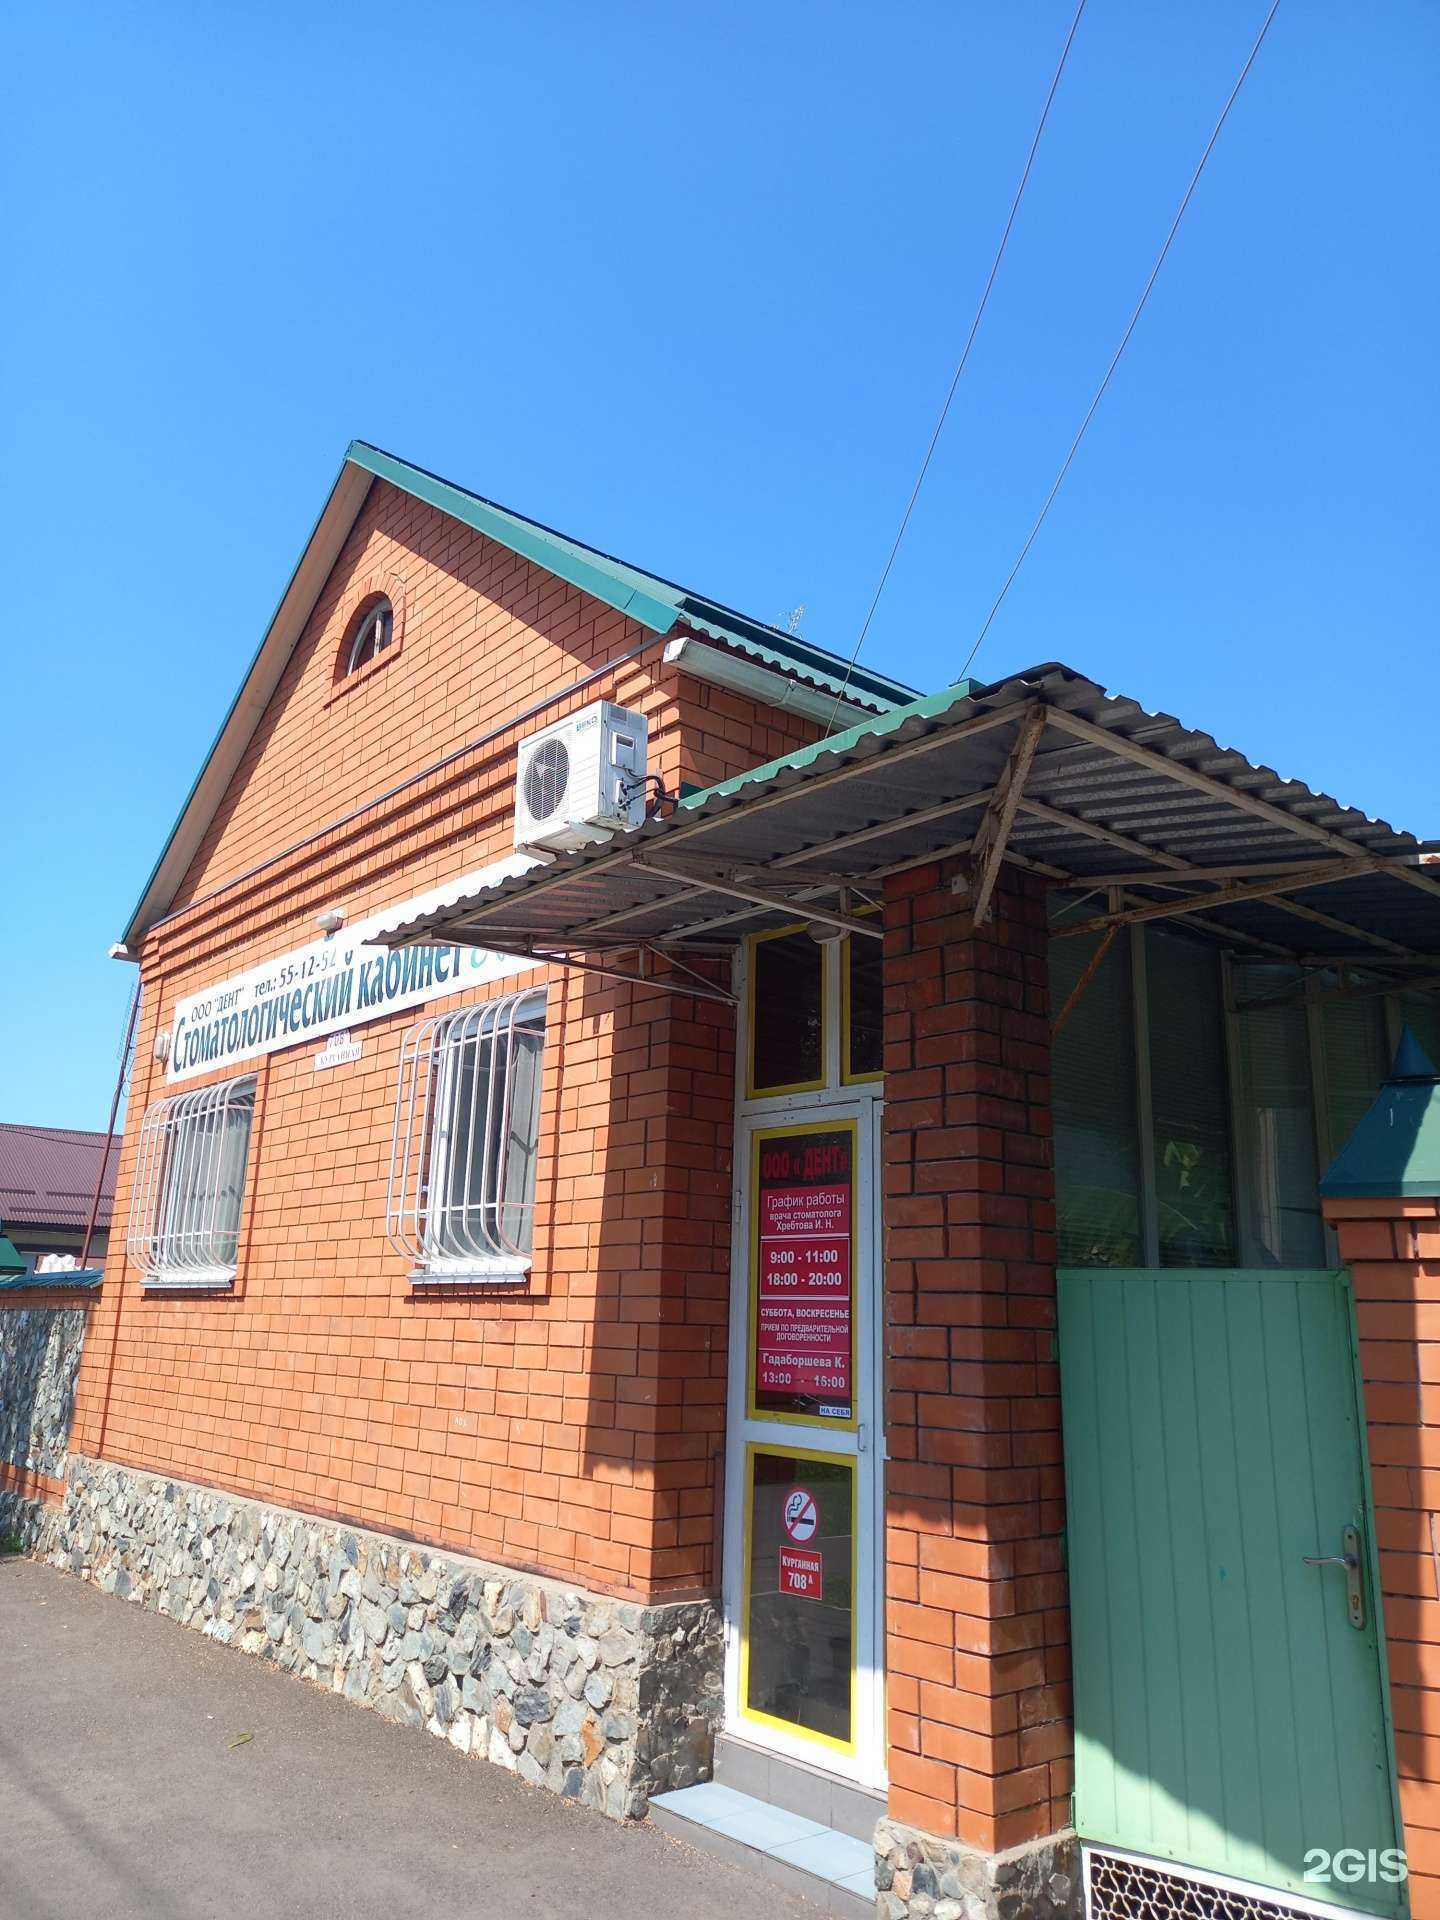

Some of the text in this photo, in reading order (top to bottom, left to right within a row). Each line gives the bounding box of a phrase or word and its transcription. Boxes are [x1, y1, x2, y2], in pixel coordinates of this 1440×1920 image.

[173, 949, 355, 1073] Стоматологический
[191, 1001, 212, 1022] ООО
[214, 987, 245, 1013] "ДЕНТ"
[764, 1151, 789, 1179] ООО
[767, 1192, 845, 1210] График работы
[769, 1209, 842, 1221] врача стоматолога
[776, 1220, 814, 1232] Хребтова
[770, 1251, 795, 1263] 9:00
[805, 1250, 838, 1263] 11:00
[767, 1272, 798, 1285] 18:00
[808, 1272, 842, 1285] 20:00
[760, 1308, 850, 1319] СУББОТА, ВОСКРЕСЕНЬЕ
[781, 1323, 790, 1332] ПО
[790, 1324, 849, 1334] ПРЕДВАРИТЕЛЬНОЙ
[775, 1332, 832, 1343] ДОГОВОРЕННОСТИ
[762, 1353, 845, 1369] Гадаборшева К.
[762, 1372, 792, 1384] 13:00
[820, 1407, 850, 1417] НА СЕБЯ
[782, 1556, 819, 1572] КУРГАННАЯ
